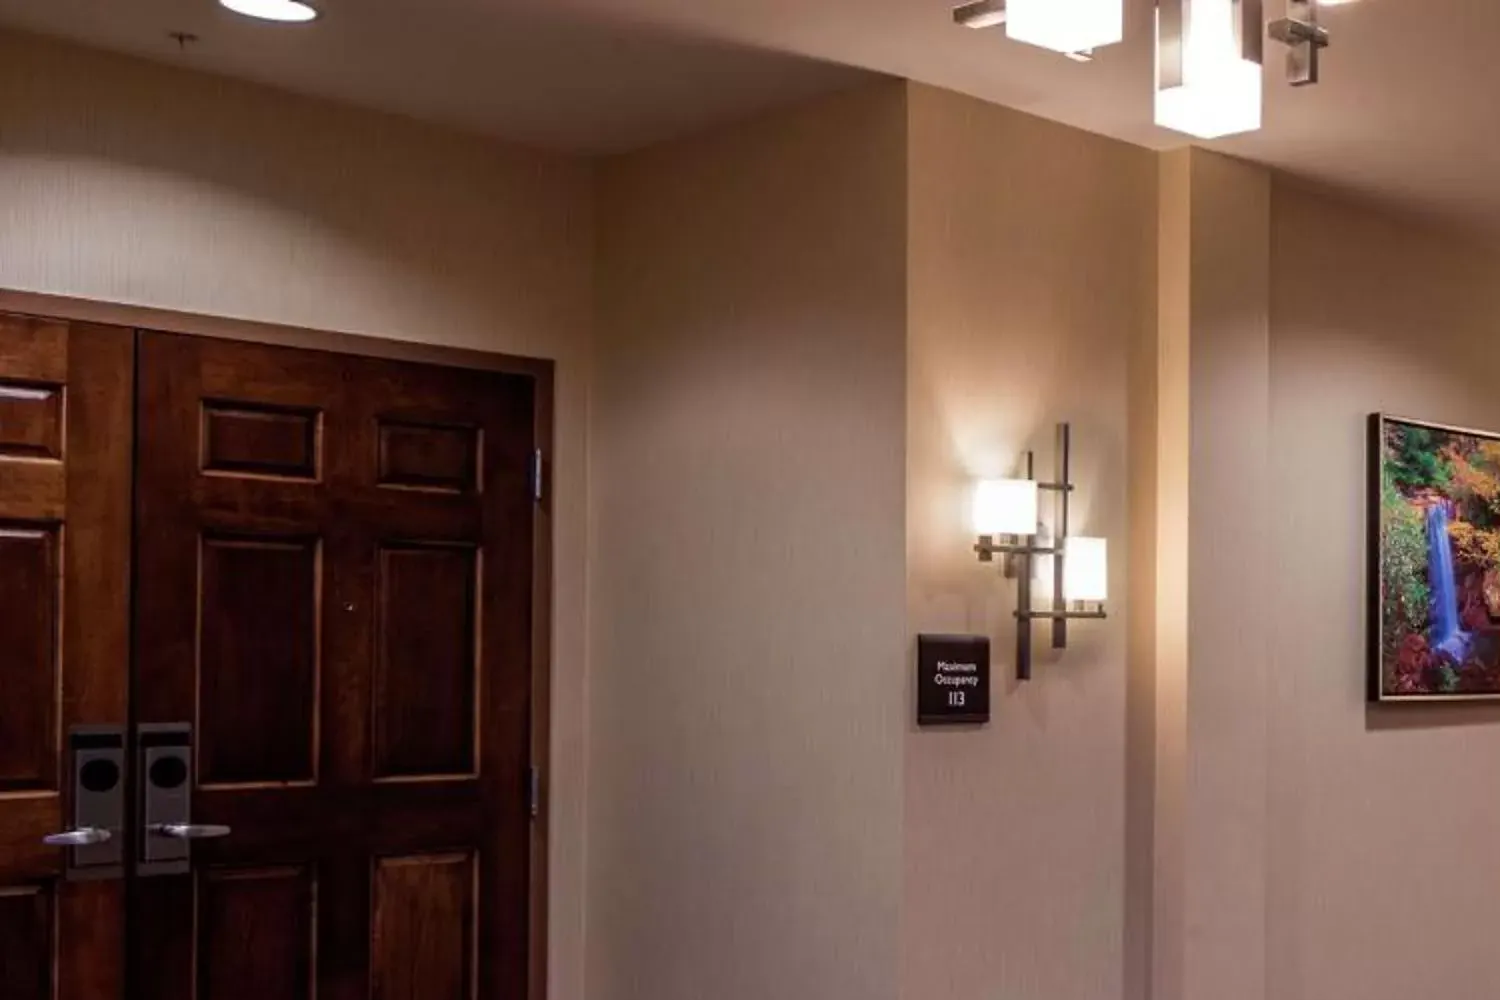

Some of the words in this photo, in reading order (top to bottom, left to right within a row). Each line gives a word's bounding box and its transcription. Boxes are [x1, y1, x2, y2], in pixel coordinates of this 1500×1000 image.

[937, 661, 976, 671] Maximum
[934, 673, 978, 688] Occupancy
[949, 691, 965, 705] 113
